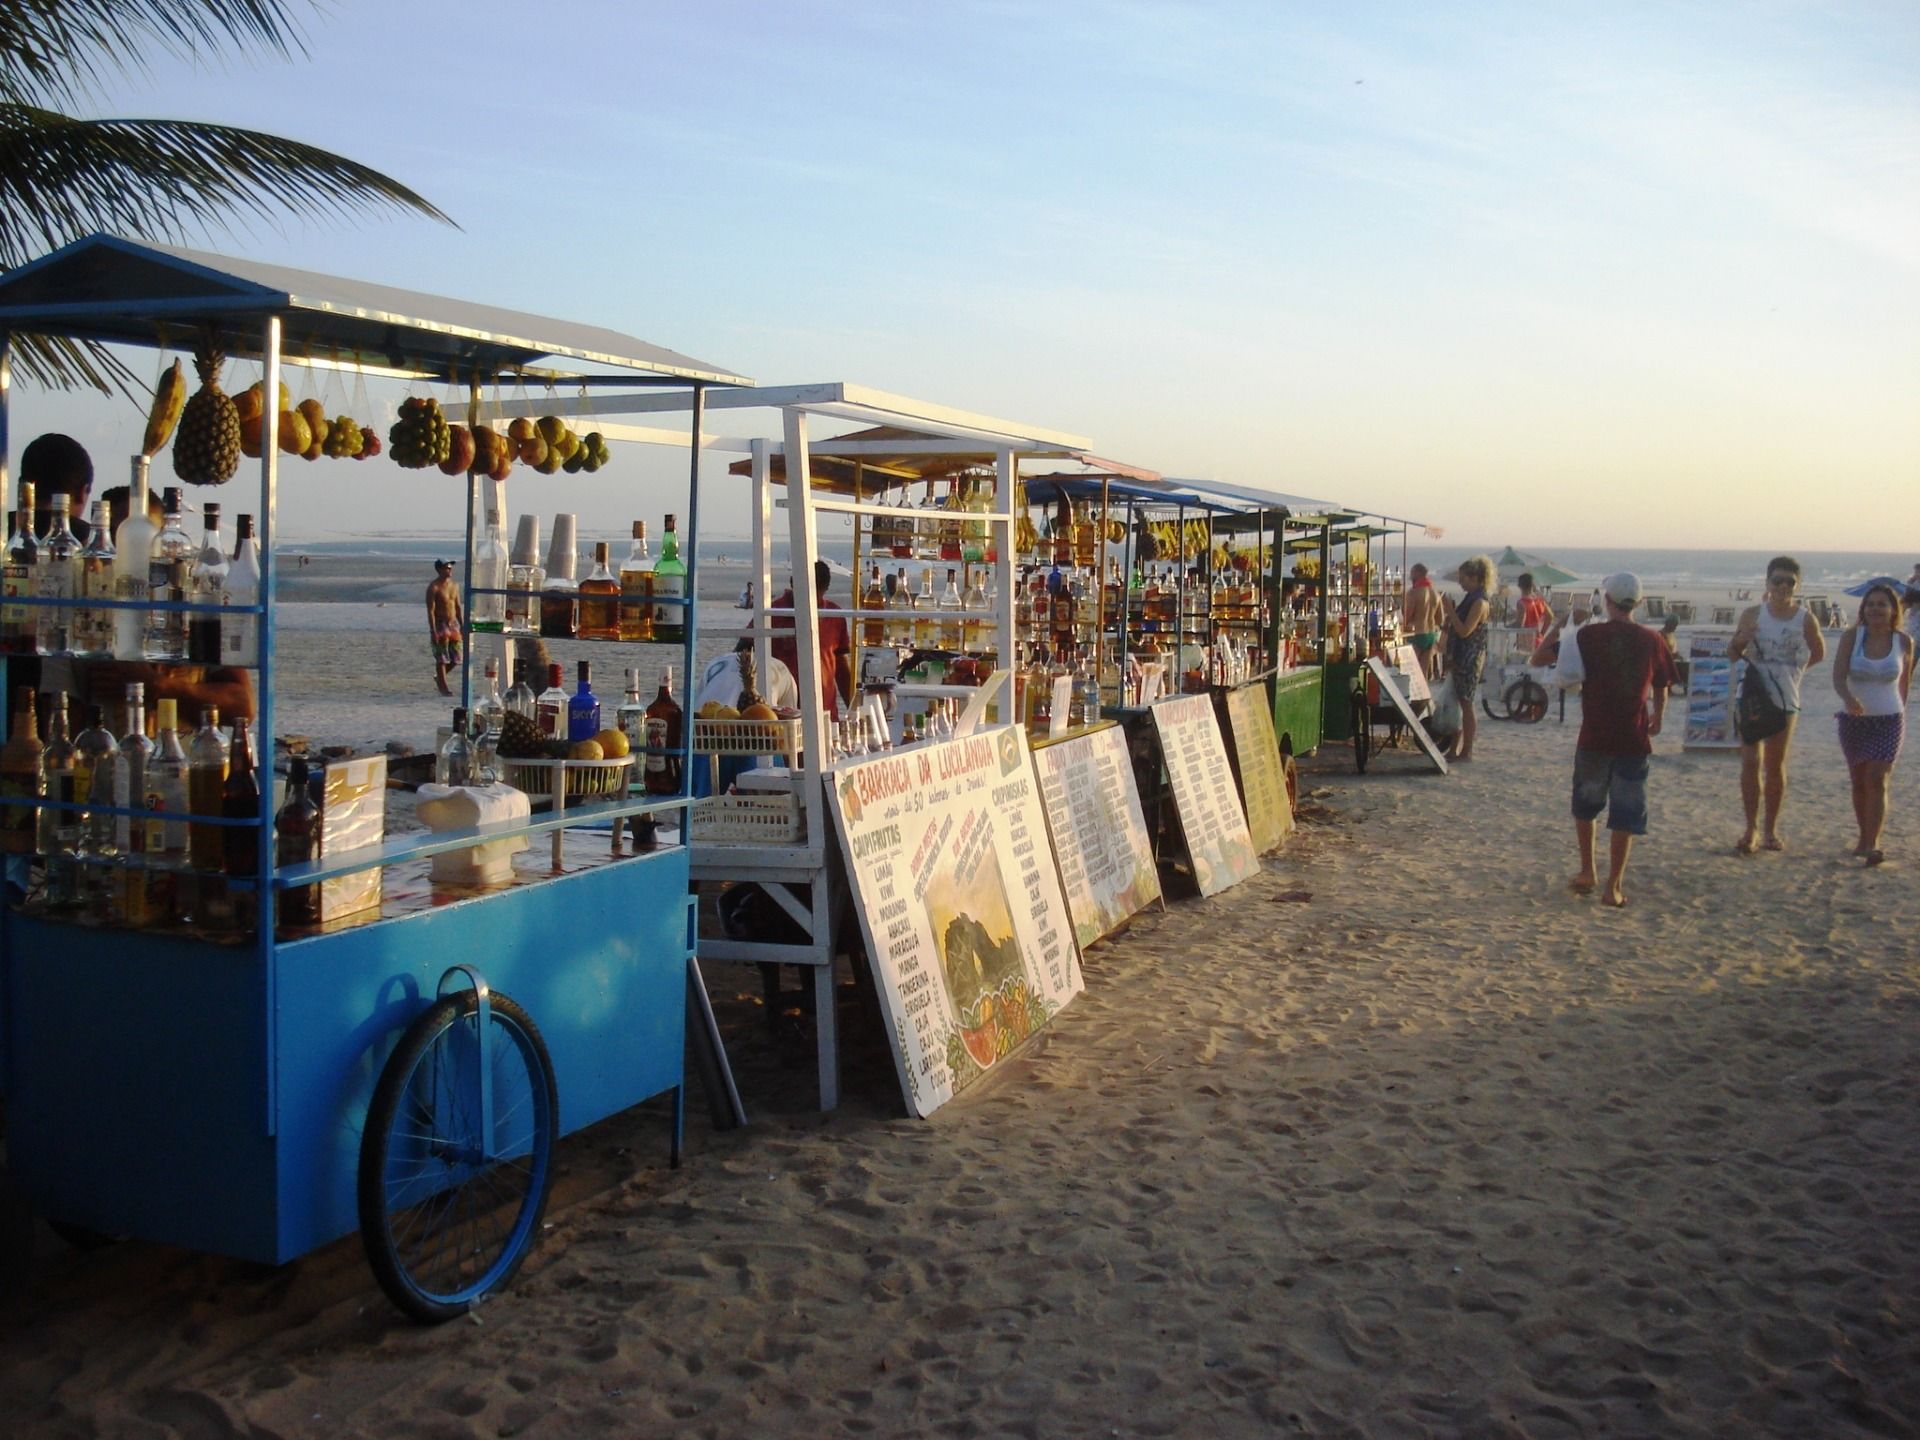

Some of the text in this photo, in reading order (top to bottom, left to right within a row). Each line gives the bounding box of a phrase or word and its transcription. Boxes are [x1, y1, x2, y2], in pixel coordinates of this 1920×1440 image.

[572, 709, 596, 720] SKYY
[857, 758, 912, 806] BARRACA
[917, 752, 932, 786] DA
[914, 790, 924, 813] 50
[852, 823, 902, 860] CAIPIFRUTAS
[874, 861, 893, 882] LIMÃO
[879, 898, 907, 923] MORANGO
[889, 928, 920, 960] MARACUJÁ
[898, 955, 919, 978] MANGA
[897, 970, 929, 1000] TANGERINA
[930, 1068, 946, 1090] COCO
